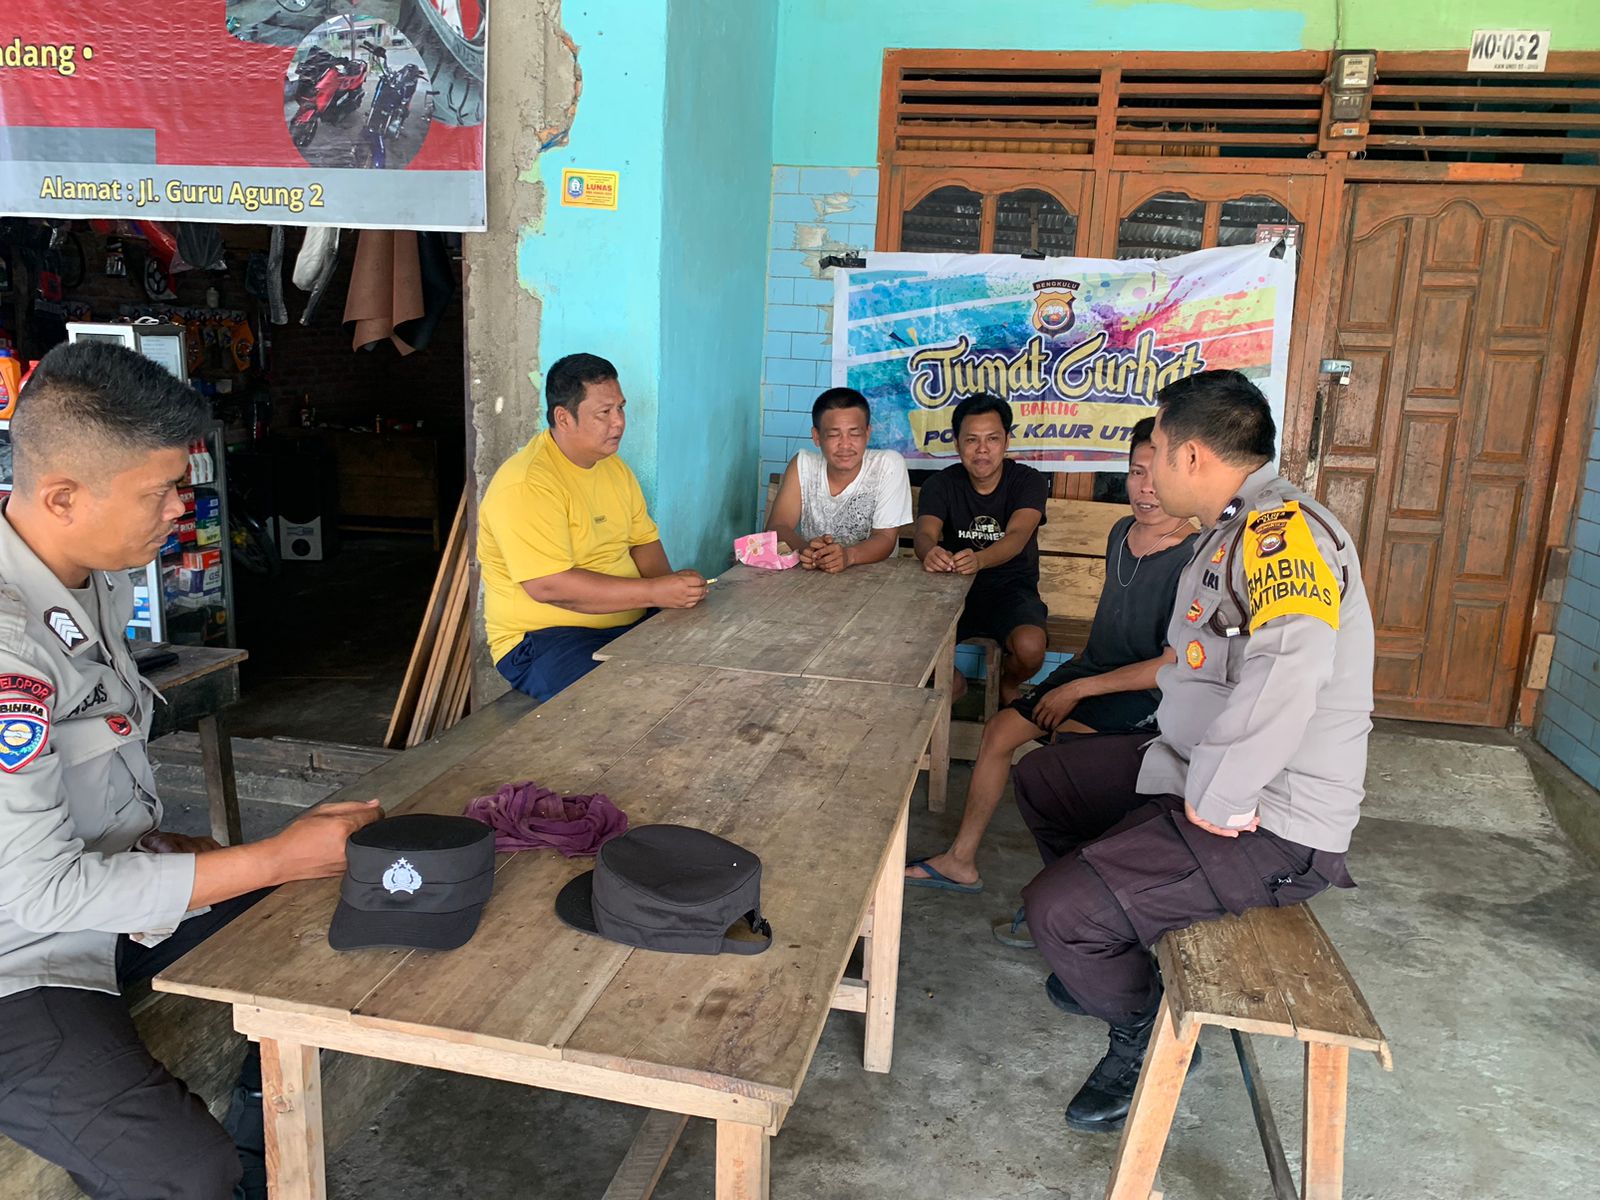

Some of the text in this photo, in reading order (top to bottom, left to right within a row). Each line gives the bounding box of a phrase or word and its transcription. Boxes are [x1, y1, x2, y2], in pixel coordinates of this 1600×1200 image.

[0, 36, 77, 77] dang
[40, 175, 122, 201] Alamat
[136, 177, 161, 208] Jl.
[165, 179, 223, 204] Guru
[227, 181, 305, 213] Agung
[308, 183, 325, 207] 2
[586, 183, 613, 192] LUNAS
[1035, 281, 1078, 289] BENGKULU
[909, 334, 1052, 410] Jumat
[1020, 401, 1079, 417] BARENG
[1022, 424, 1095, 439] KAUR
[975, 523, 995, 533] LIFE
